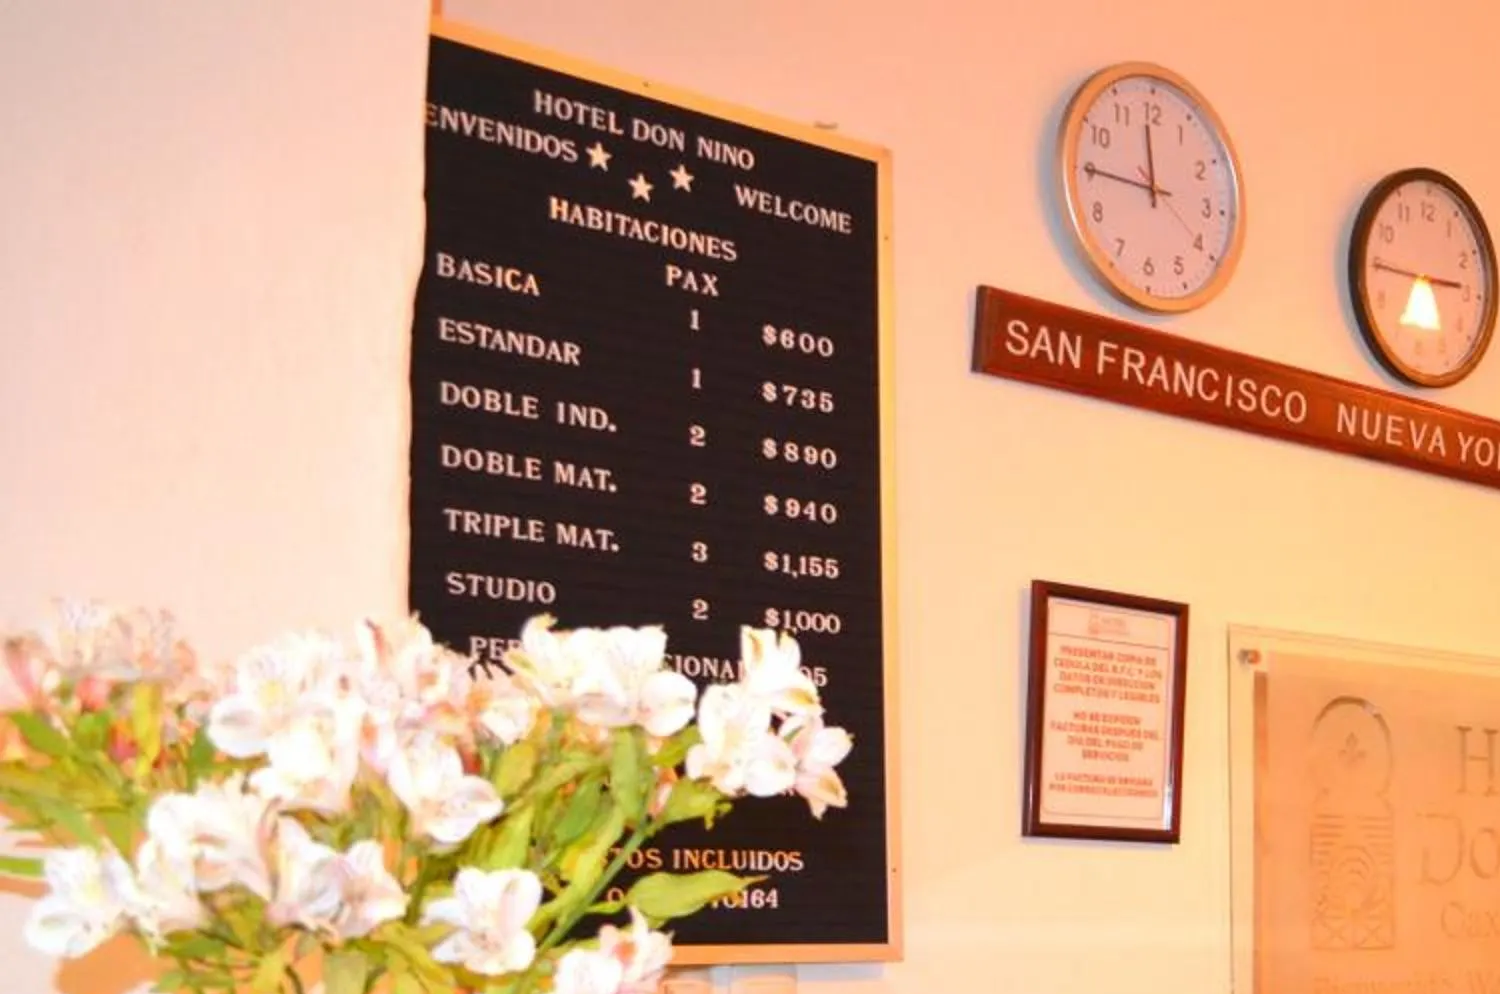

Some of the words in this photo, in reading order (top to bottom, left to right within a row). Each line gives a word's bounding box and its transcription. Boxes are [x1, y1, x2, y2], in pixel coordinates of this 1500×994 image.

[532, 89, 624, 136] HOTEL
[633, 119, 684, 151] DON
[698, 137, 754, 170] NINO
[1091, 126, 1110, 149] 10
[1114, 103, 1130, 127] 11
[1143, 101, 1162, 126] 12
[426, 102, 579, 162] ENVENIDOS
[735, 185, 851, 233] WELCOME
[550, 196, 738, 261] HABITACIONES
[437, 253, 539, 296] BASICA
[690, 309, 700, 331] 1
[763, 325, 833, 356] $600
[666, 265, 718, 296] PAX
[440, 318, 580, 365] ESTANDAR
[692, 368, 701, 389] 1
[763, 382, 833, 412] $735
[1005, 319, 1082, 369] SAN
[1096, 340, 1307, 424] FRANCISCO
[441, 382, 538, 418] DOBLE
[558, 402, 616, 432] IND.
[690, 425, 705, 446] 2
[763, 438, 836, 468] $890
[1336, 403, 1446, 457] NUEVA
[442, 445, 541, 480] DOBLE
[555, 462, 616, 492] MAT.
[691, 484, 706, 504] 2
[764, 495, 837, 523] $940
[444, 509, 544, 542] TRIPLE
[557, 523, 619, 551] MAT.
[693, 542, 707, 562] 3
[765, 552, 838, 578] $1,155
[447, 572, 556, 603] STUDIO
[693, 599, 708, 620] 2
[764, 609, 841, 634] $1,000
[673, 848, 804, 871] INCLUIDOS
